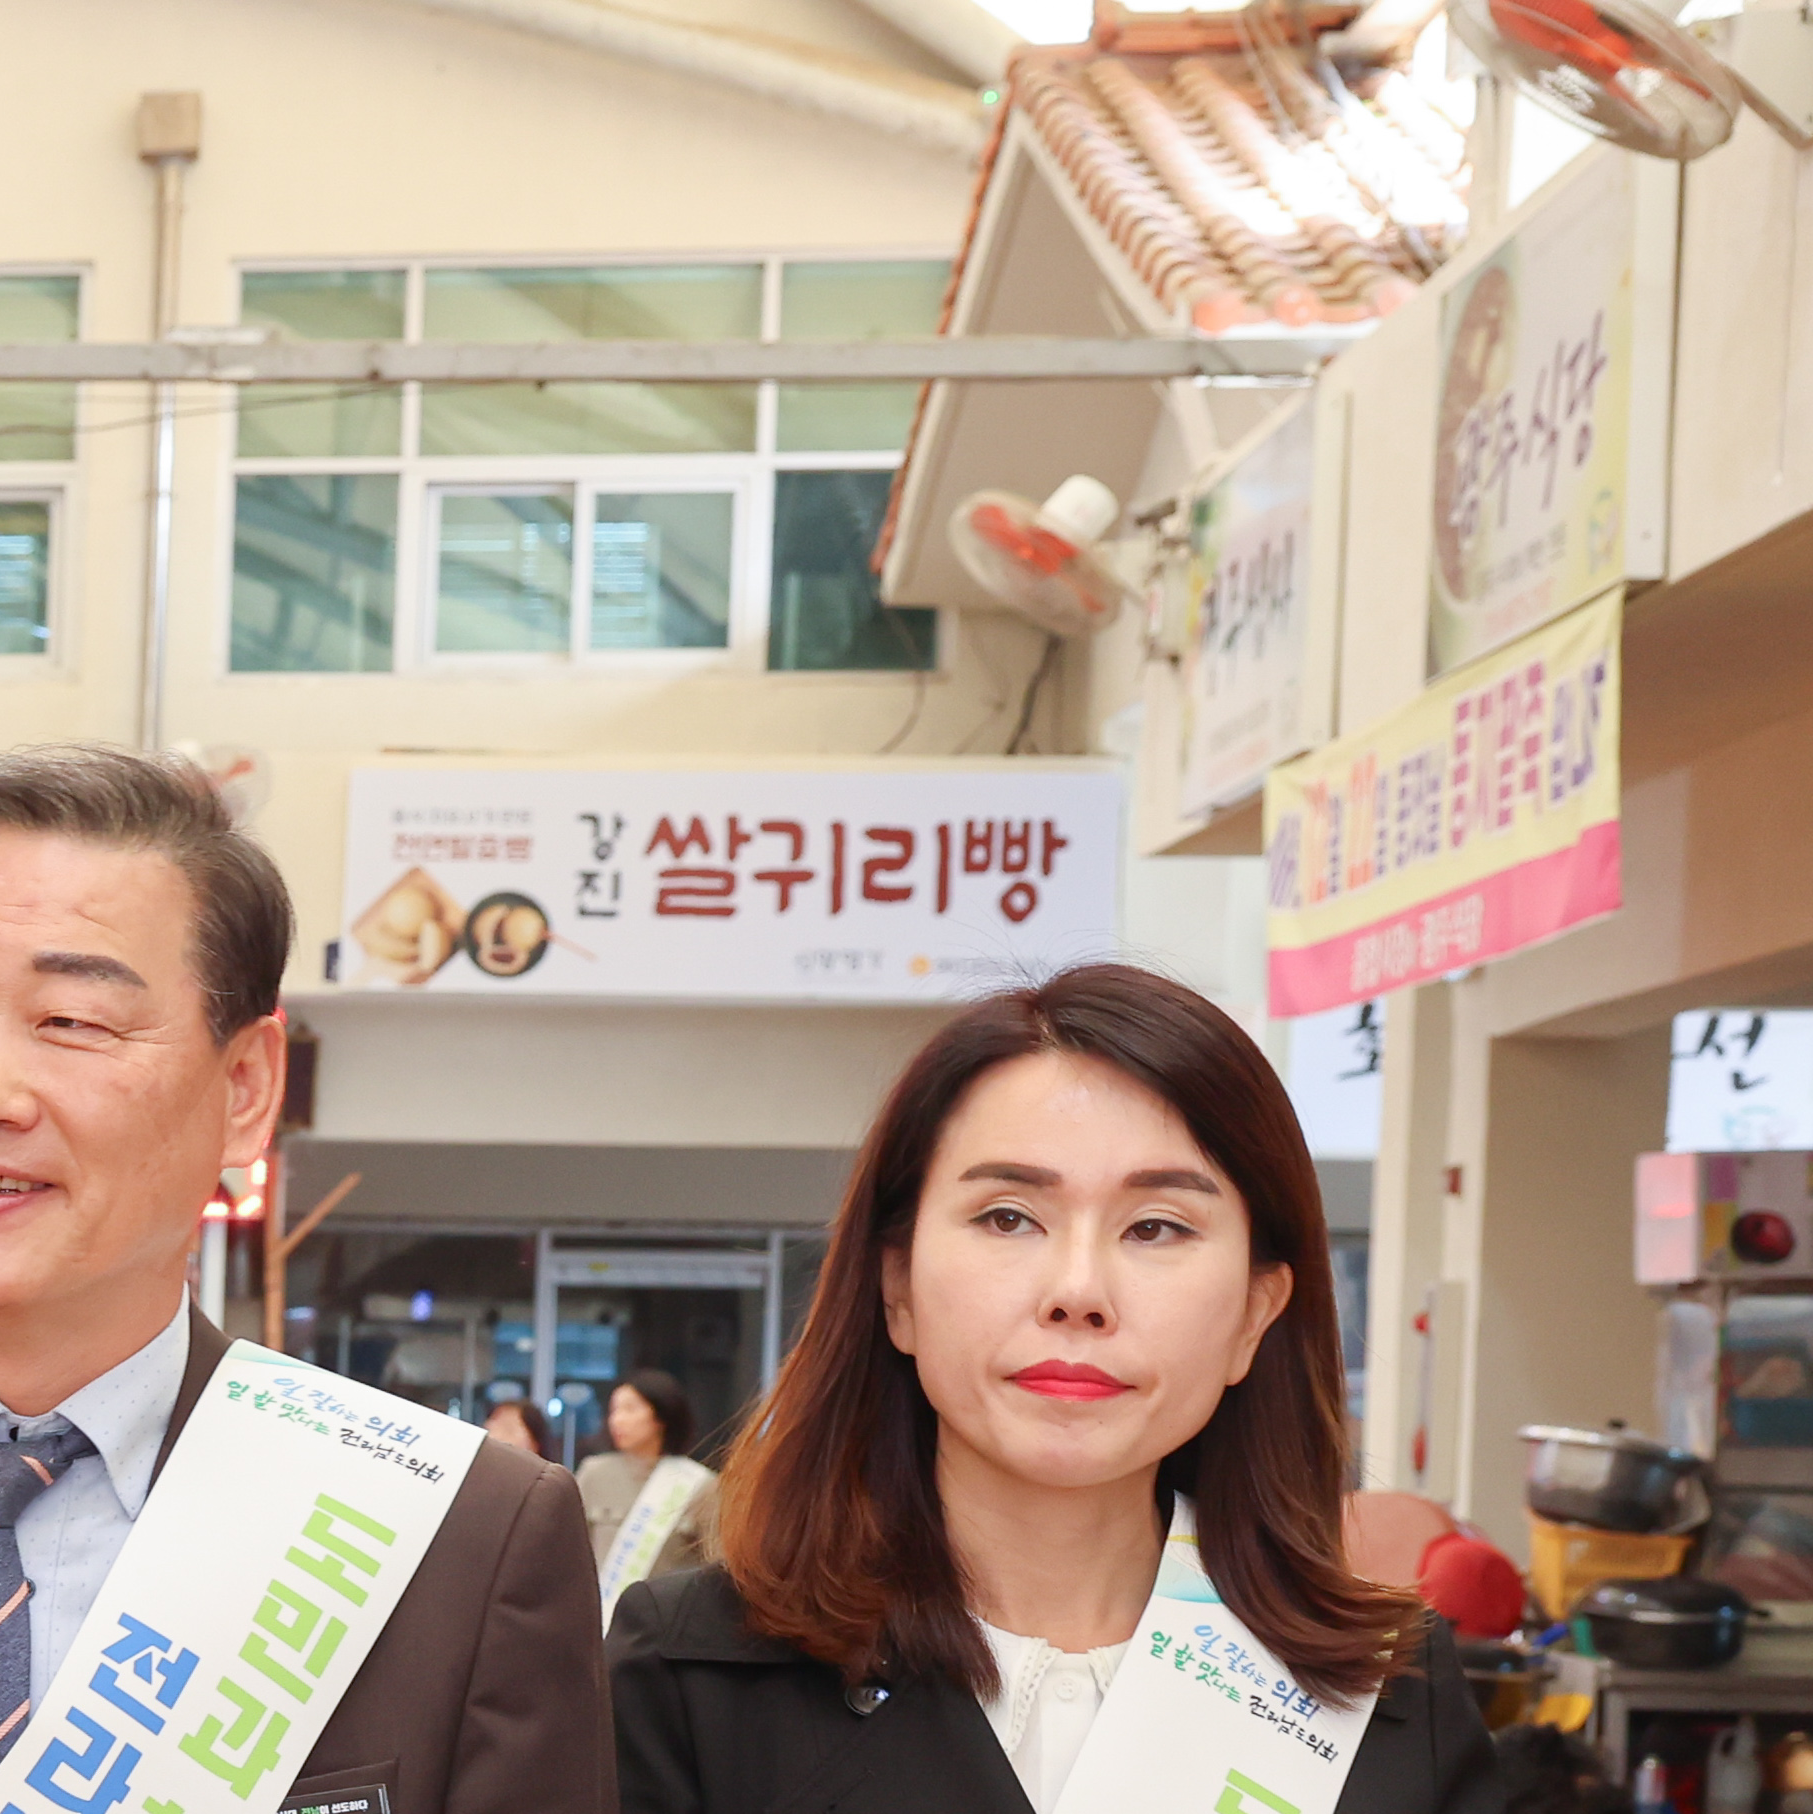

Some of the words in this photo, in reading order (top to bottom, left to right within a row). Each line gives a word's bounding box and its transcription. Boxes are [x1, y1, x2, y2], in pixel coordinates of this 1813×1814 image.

[575, 811, 627, 919] 강진
[644, 812, 1073, 924] 쌀귀리빵
[226, 1380, 250, 1403] 일
[338, 1427, 446, 1485] 전라남도의회
[273, 1376, 305, 1402] 일
[364, 1414, 422, 1449] 의회
[177, 1492, 398, 1802] 도민과
[1149, 1629, 1173, 1660] 일
[1247, 1693, 1340, 1766] 전라남도의회
[1192, 1623, 1223, 1661] 일
[1270, 1678, 1322, 1723] 의회
[330, 1798, 370, 1814] 선도하다
